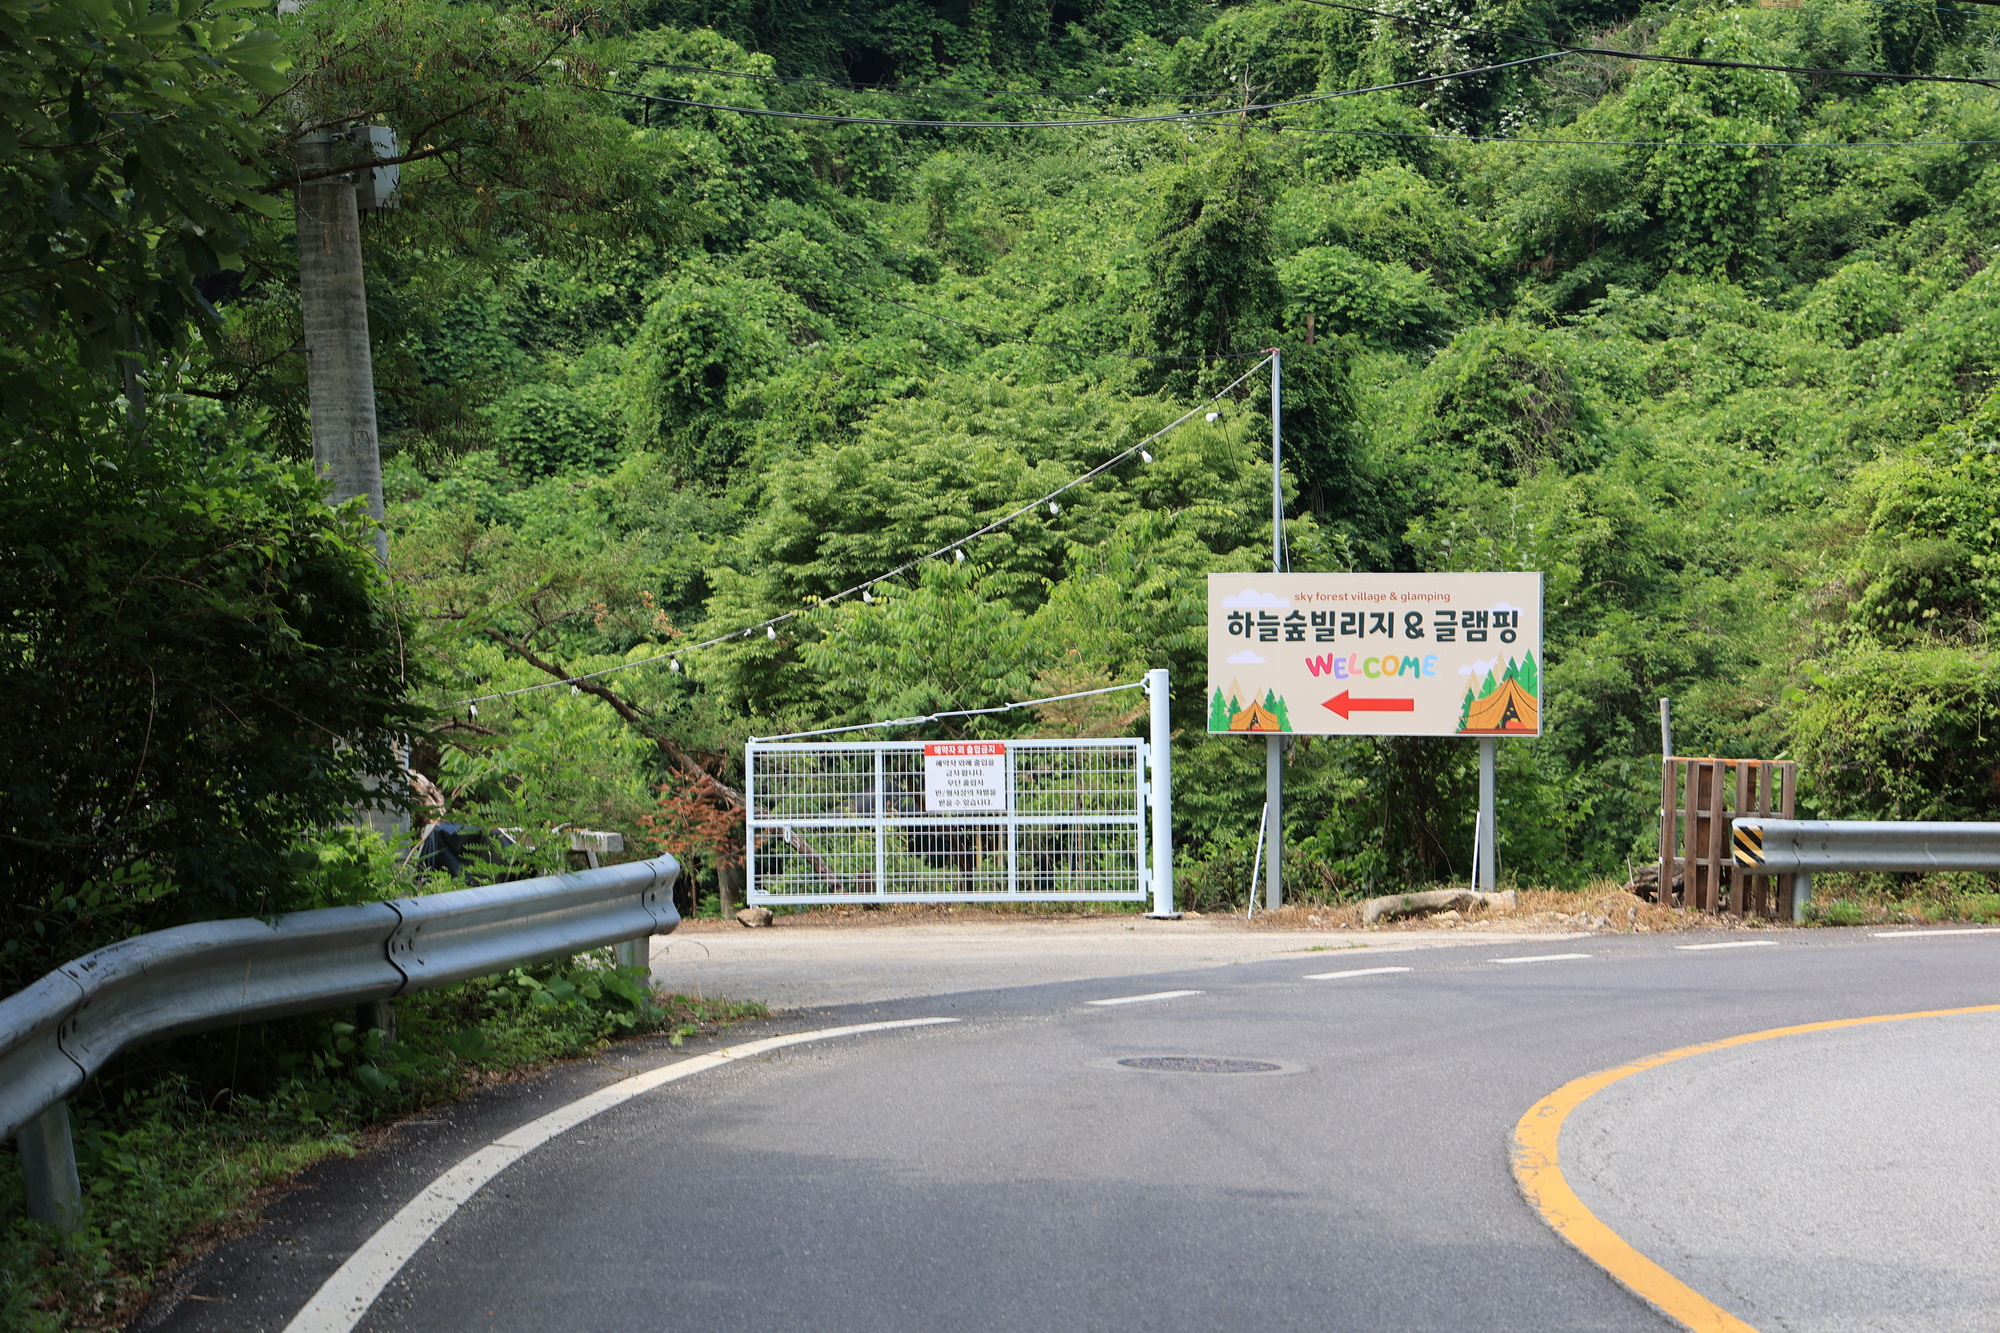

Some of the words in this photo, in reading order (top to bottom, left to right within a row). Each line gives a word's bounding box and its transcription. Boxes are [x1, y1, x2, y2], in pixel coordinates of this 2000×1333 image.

[1294, 591, 1313, 603] sky
[1316, 591, 1349, 601] forest
[1351, 591, 1387, 603] village
[1389, 591, 1398, 601] &
[1400, 591, 1451, 603] glamping
[1227, 609, 1395, 643] 하늘숲빌리지
[1404, 610, 1425, 640] &
[1433, 609, 1518, 644] 글램핑
[1305, 652, 1438, 680] WELCOME
[933, 745, 956, 756] 예약자
[957, 745, 965, 755] 외
[966, 744, 996, 755] 출입금지
[954, 800, 961, 808] 수
